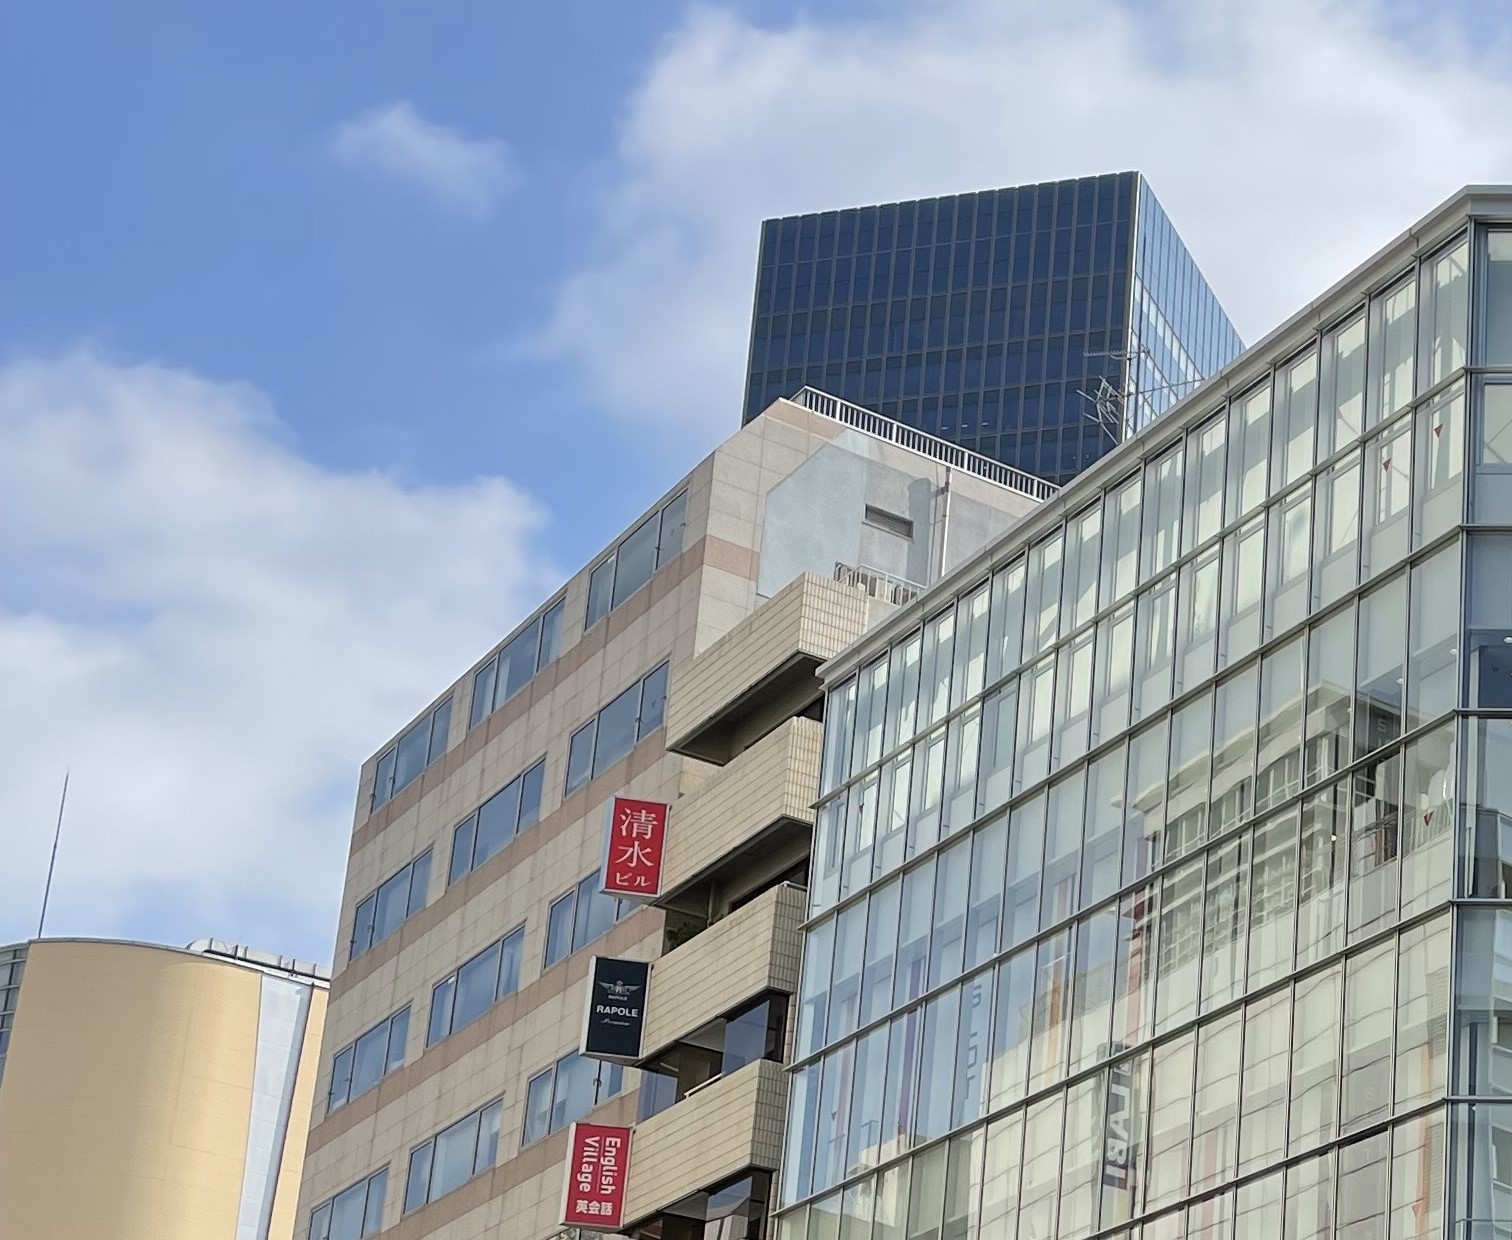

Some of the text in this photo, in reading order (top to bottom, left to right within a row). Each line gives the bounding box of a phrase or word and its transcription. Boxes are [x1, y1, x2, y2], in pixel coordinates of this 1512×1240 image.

[614, 807, 658, 867] 清水
[615, 872, 650, 888] ビル
[597, 1004, 639, 1018] RAPOLE
[575, 1135, 600, 1193] Village
[600, 1137, 622, 1195] English
[575, 1199, 613, 1216] 英会話
